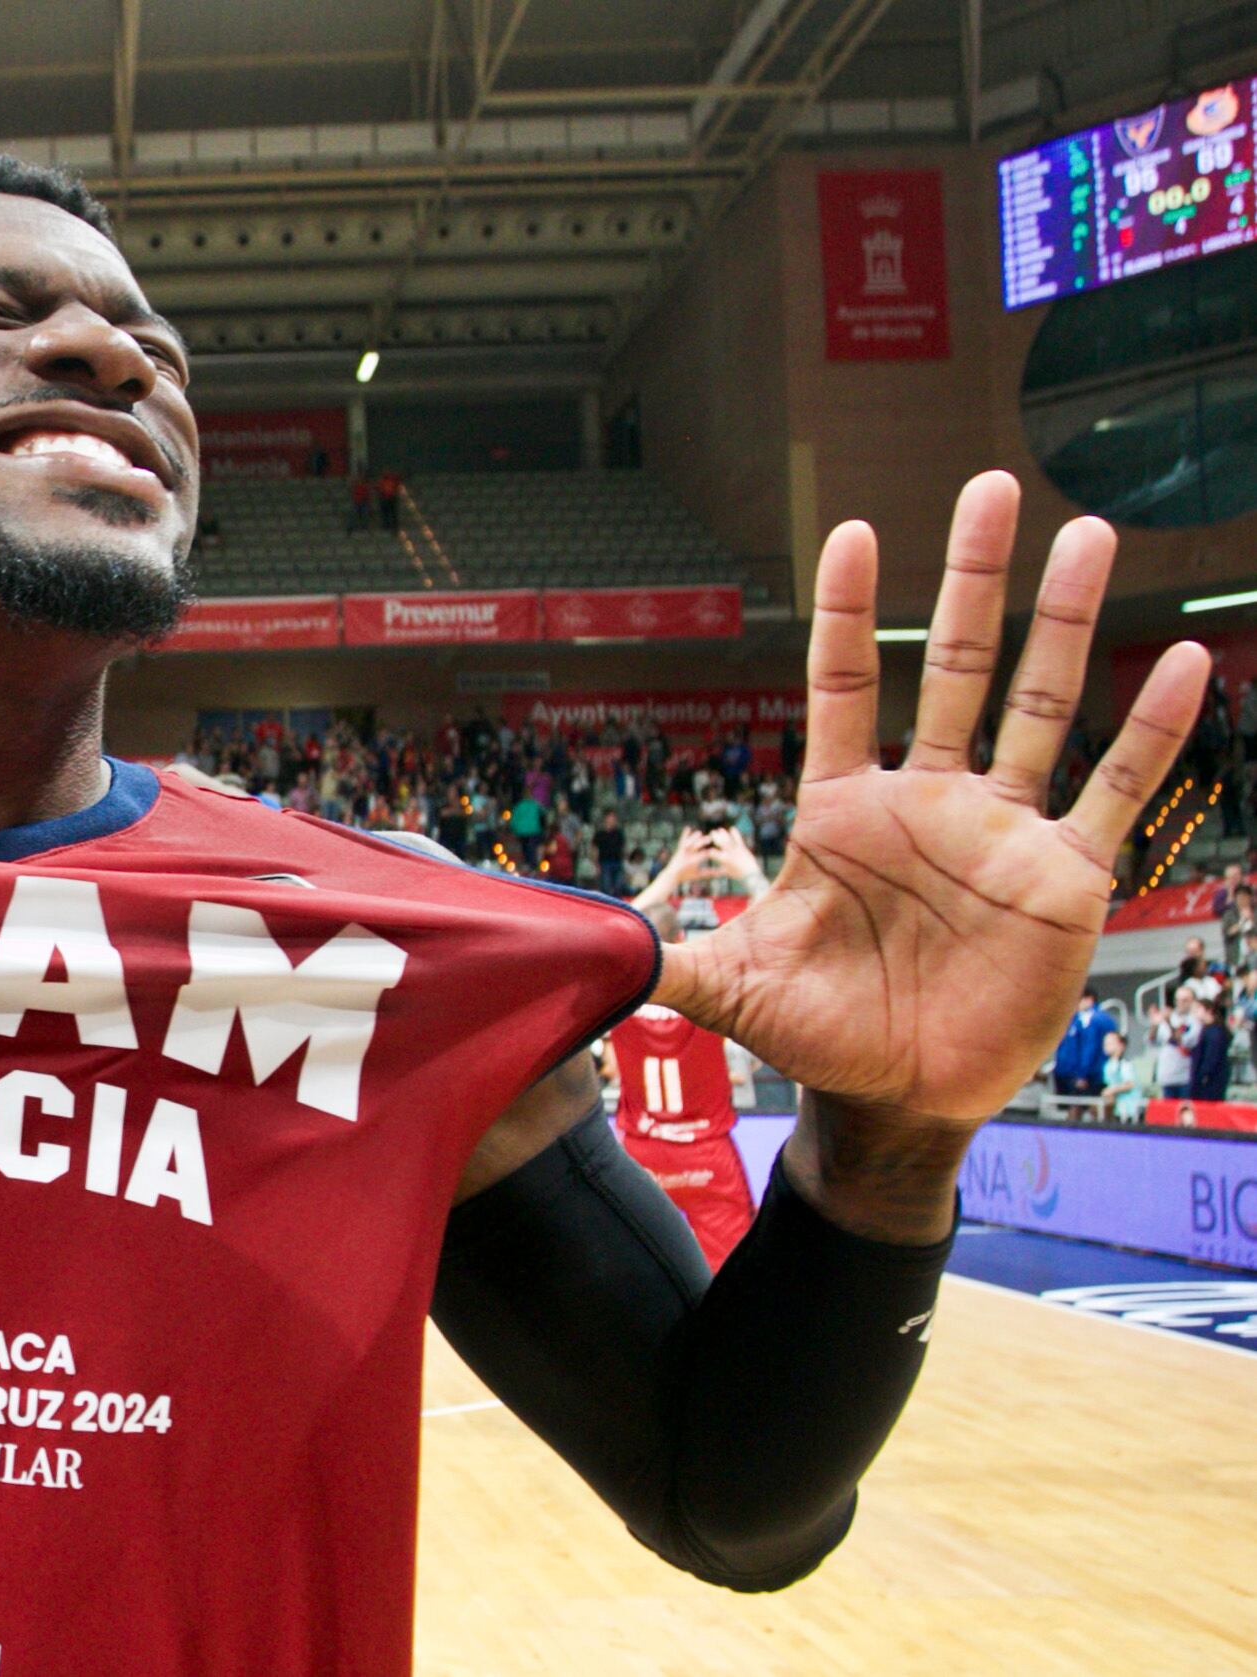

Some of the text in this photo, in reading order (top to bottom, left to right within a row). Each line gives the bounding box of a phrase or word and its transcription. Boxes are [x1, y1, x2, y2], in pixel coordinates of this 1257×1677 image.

[384, 599, 499, 625] Prevemur
[643, 1055, 683, 1114] 11
[72, 1391, 173, 1434] 2024
